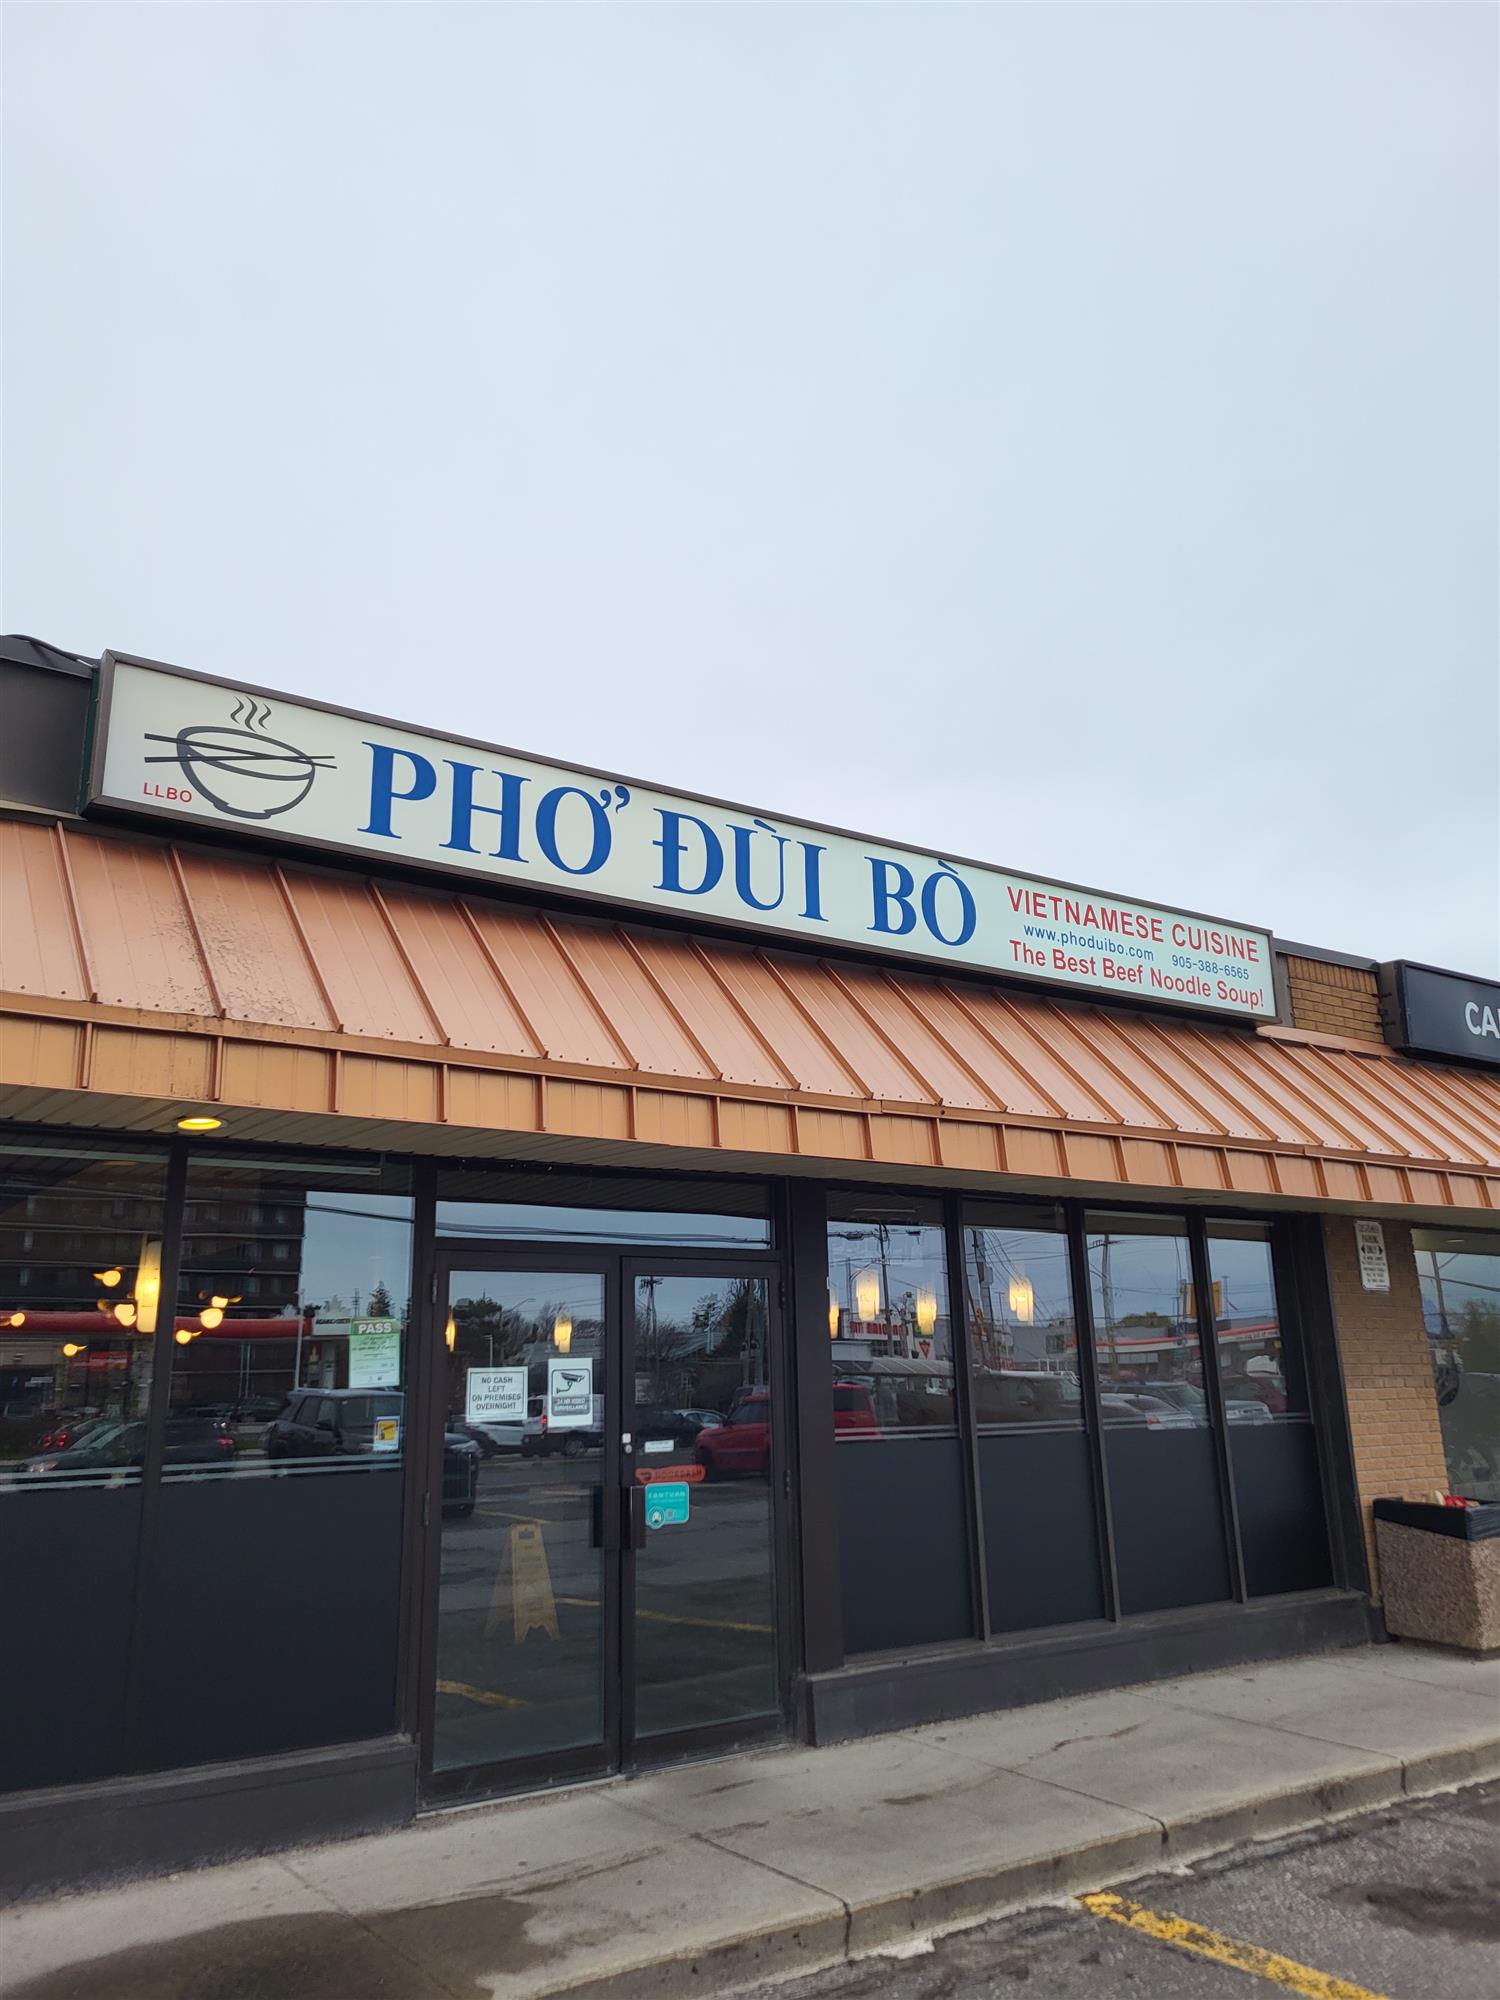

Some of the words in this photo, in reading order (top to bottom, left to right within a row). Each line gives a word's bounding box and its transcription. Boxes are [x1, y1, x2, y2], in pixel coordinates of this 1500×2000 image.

[143, 782, 192, 803] LLBO
[653, 808, 828, 922] ĐÙI
[865, 859, 977, 946] BÒ
[1007, 886, 1164, 943] VIETNAMESE
[1172, 924, 1260, 963] CUISINE
[1023, 924, 1154, 961] www.phoduibo.com
[1171, 954, 1249, 980] 905-388-6565
[1009, 940, 1046, 967] The
[1052, 948, 1097, 976] Best
[1103, 957, 1143, 984] Beef
[1150, 968, 1212, 997] Noodle
[1217, 981, 1264, 1009] Soup!
[1464, 1001, 1500, 1039] CA
[358, 1322, 392, 1335] PASS
[481, 1376, 492, 1384] NO
[493, 1376, 513, 1384] CASH
[488, 1385, 506, 1393] LEFT
[472, 1394, 482, 1402] ON
[483, 1393, 522, 1401] PREMISES
[476, 1402, 517, 1410] OVERNIGHT
